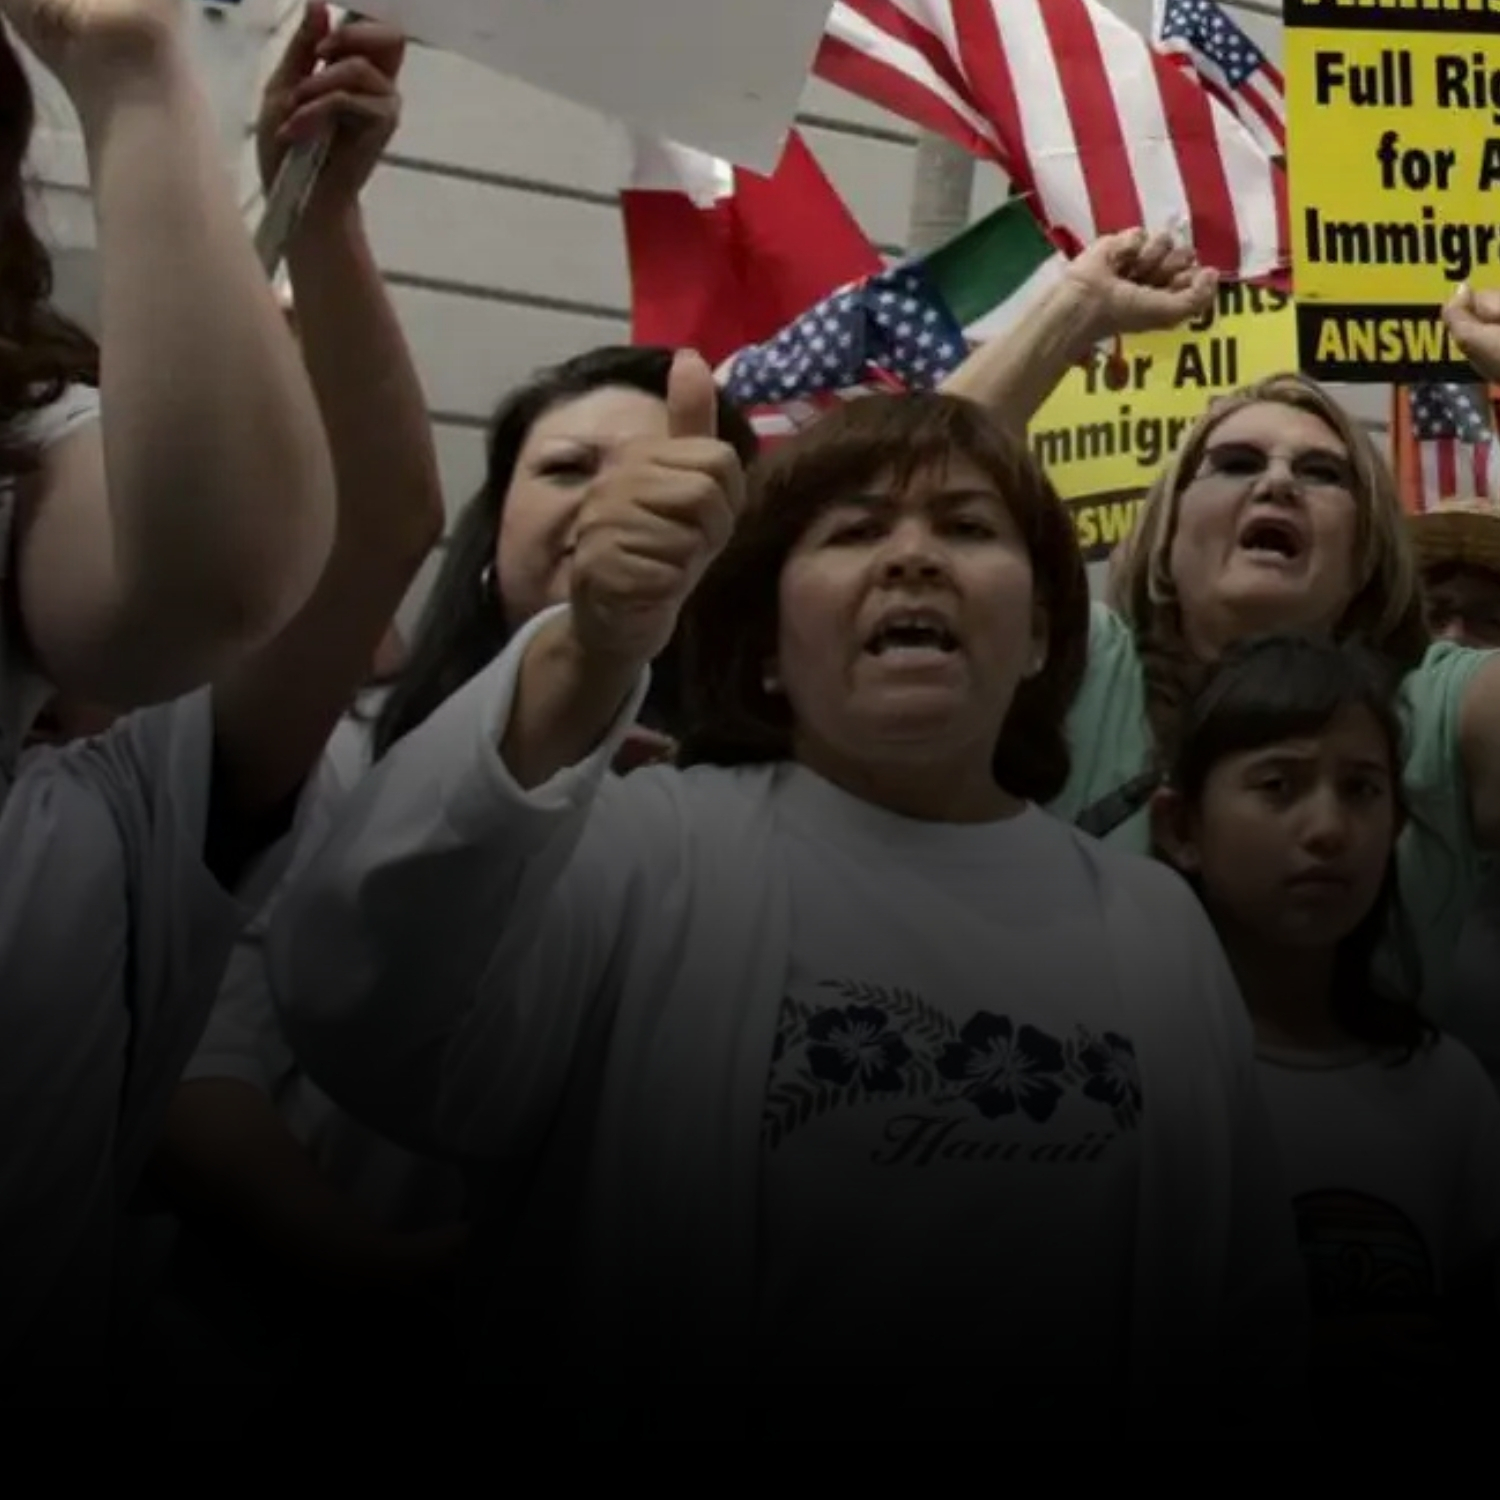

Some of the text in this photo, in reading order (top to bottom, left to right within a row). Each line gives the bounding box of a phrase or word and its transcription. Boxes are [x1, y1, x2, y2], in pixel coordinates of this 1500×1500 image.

[1314, 51, 1412, 107] Full
[1376, 131, 1456, 192] for
[1173, 337, 1239, 389] All
[870, 1113, 1115, 1168] Hawaii
